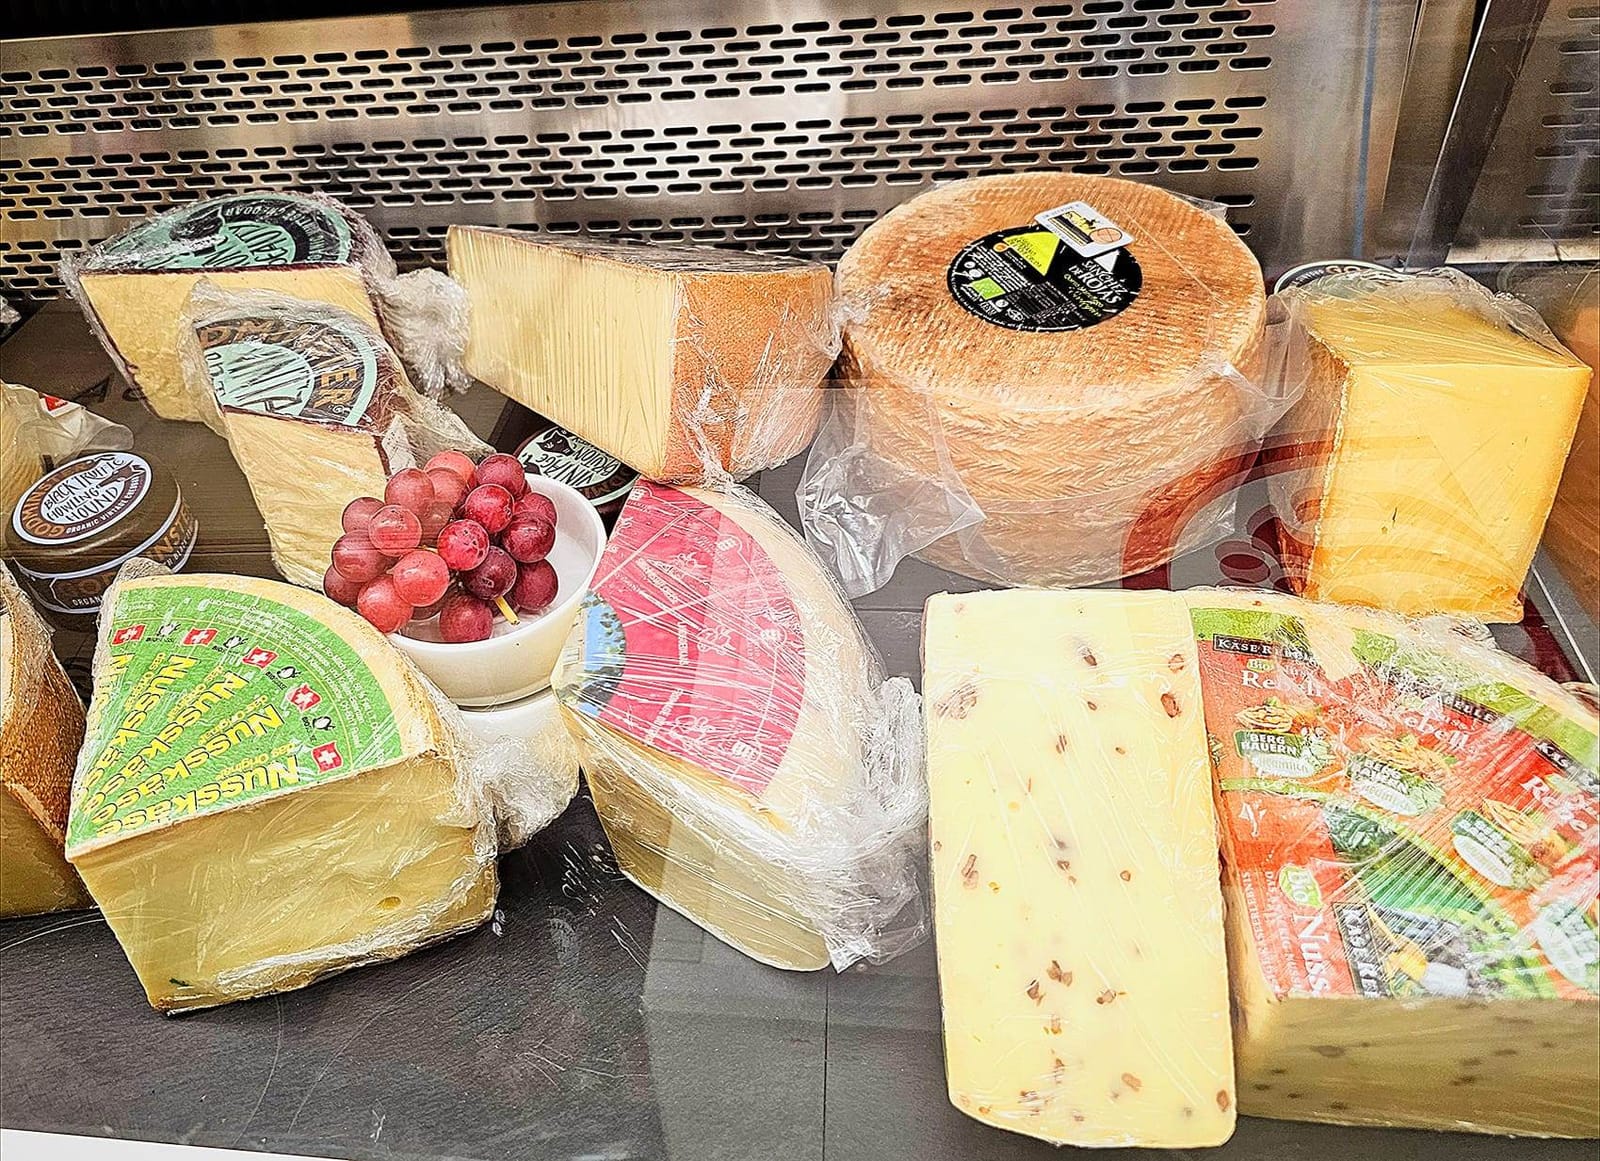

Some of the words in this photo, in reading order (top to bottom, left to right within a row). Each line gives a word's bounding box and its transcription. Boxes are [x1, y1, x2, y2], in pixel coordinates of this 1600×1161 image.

[226, 207, 285, 216] CHEDDAR
[1069, 265, 1082, 277] DE
[1081, 271, 1122, 305] ROJAS
[44, 481, 77, 510] BLACK
[75, 458, 125, 487] TRUFFLE
[536, 452, 595, 487] VINTAGE
[46, 488, 100, 521] HOWLING
[65, 486, 119, 521] HOUND
[66, 518, 100, 535] ORGANIC
[100, 498, 131, 521] VINTAGE
[72, 594, 103, 606] ORGAN
[245, 694, 268, 714] das
[84, 669, 251, 817] Nusskäse
[199, 708, 245, 746] Original
[1249, 731, 1286, 745] BERG
[91, 702, 286, 827] Nusskäse
[215, 751, 270, 779] Original
[272, 742, 296, 758] das
[1241, 740, 1297, 756] BAUERN
[96, 754, 301, 838] Nusskäse
